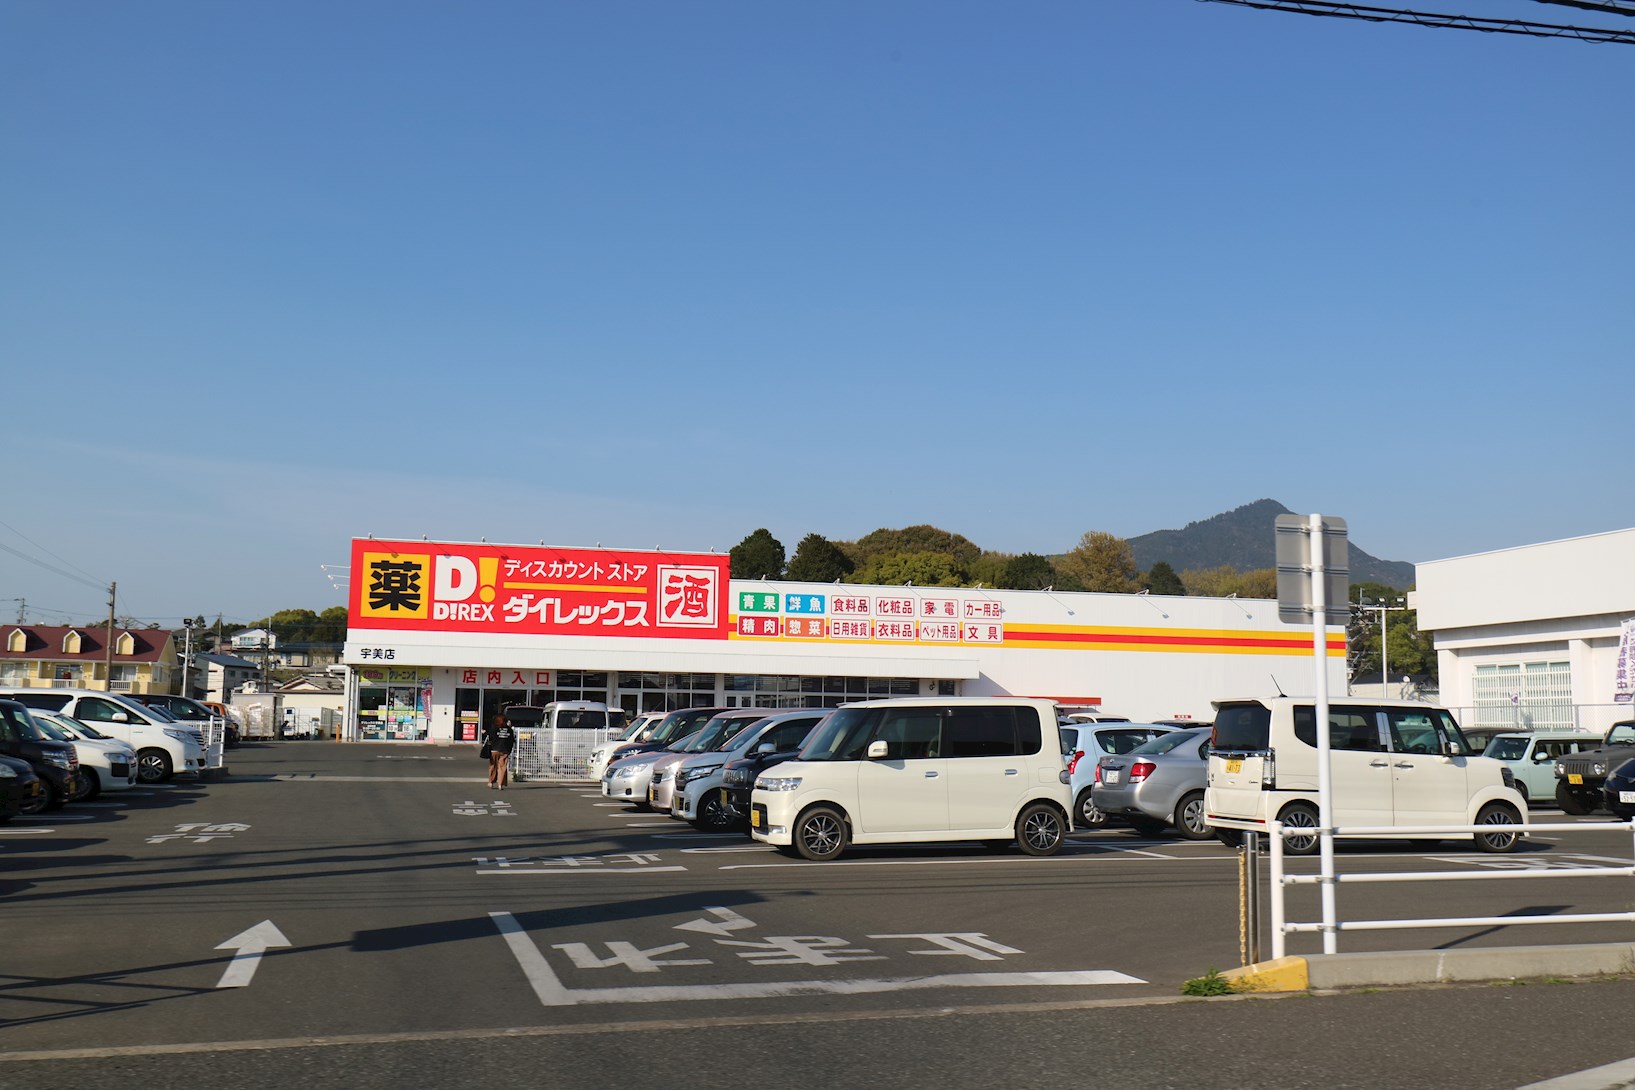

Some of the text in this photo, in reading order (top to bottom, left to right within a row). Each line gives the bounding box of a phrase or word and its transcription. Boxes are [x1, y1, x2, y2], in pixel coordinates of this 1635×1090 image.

[504, 559, 648, 582] ディスカウント ストア
[368, 560, 422, 611] 薬
[434, 555, 499, 603] D!
[665, 574, 710, 619] 酒
[743, 594, 776, 610] 青果
[789, 596, 822, 612] 鮮魚
[502, 594, 650, 627] ダイレックス
[833, 598, 868, 613] 食料品
[878, 599, 912, 614] 化粧品
[924, 601, 955, 616] 家電
[966, 603, 1000, 617] カー用品
[742, 618, 776, 634] 精肉
[788, 619, 821, 635] 惣菜
[833, 622, 868, 636] 日用雑貨
[878, 623, 912, 637] 衣料品
[922, 625, 957, 639] ペット用品
[968, 626, 998, 640] 文具
[360, 648, 396, 660] 宇美店
[462, 669, 550, 686] 店内入口
[471, 853, 663, 867] 止まれ
[551, 932, 1026, 973] 止まれ
